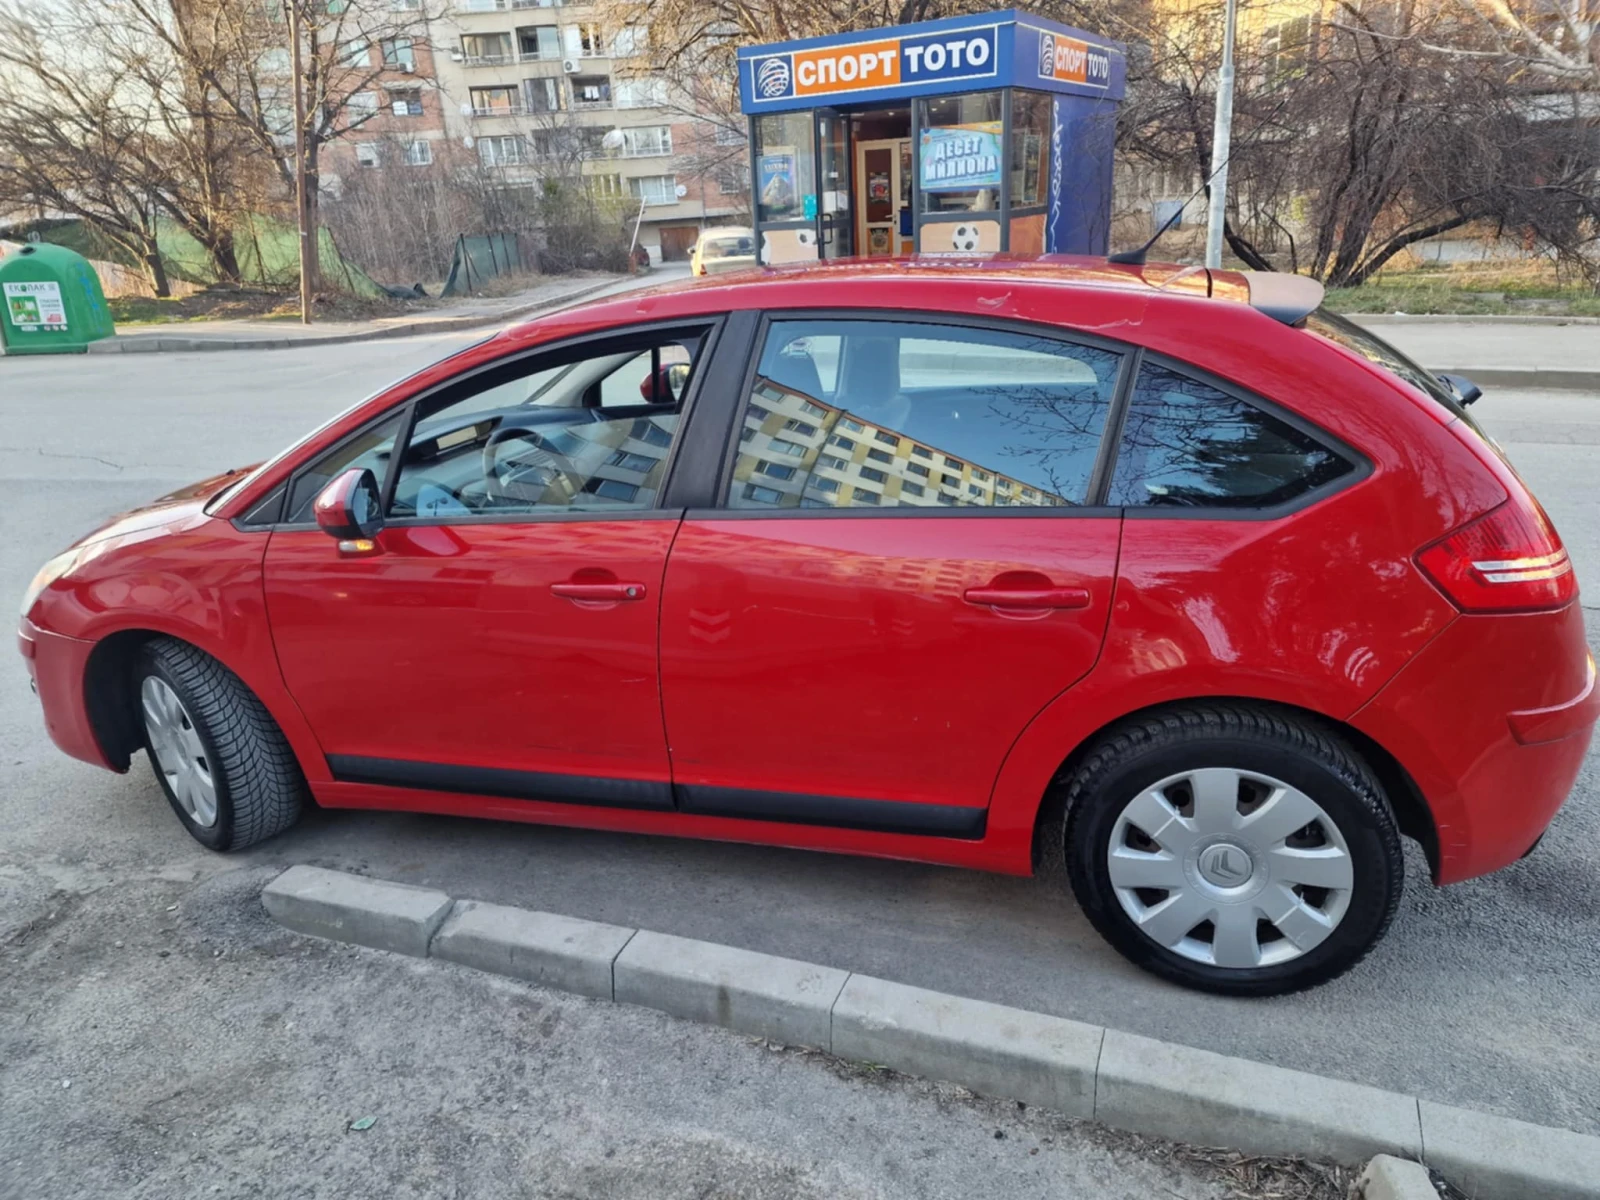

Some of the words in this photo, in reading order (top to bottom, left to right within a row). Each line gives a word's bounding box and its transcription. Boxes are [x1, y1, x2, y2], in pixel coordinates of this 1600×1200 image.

[797, 50, 897, 86] СПОРТ
[904, 38, 990, 73] ТОТО
[1055, 45, 1087, 75] СПОРТ
[1087, 53, 1109, 79] ТОТО
[935, 136, 981, 162] ДЕСЕТ
[925, 155, 998, 181] МИЛИОНА
